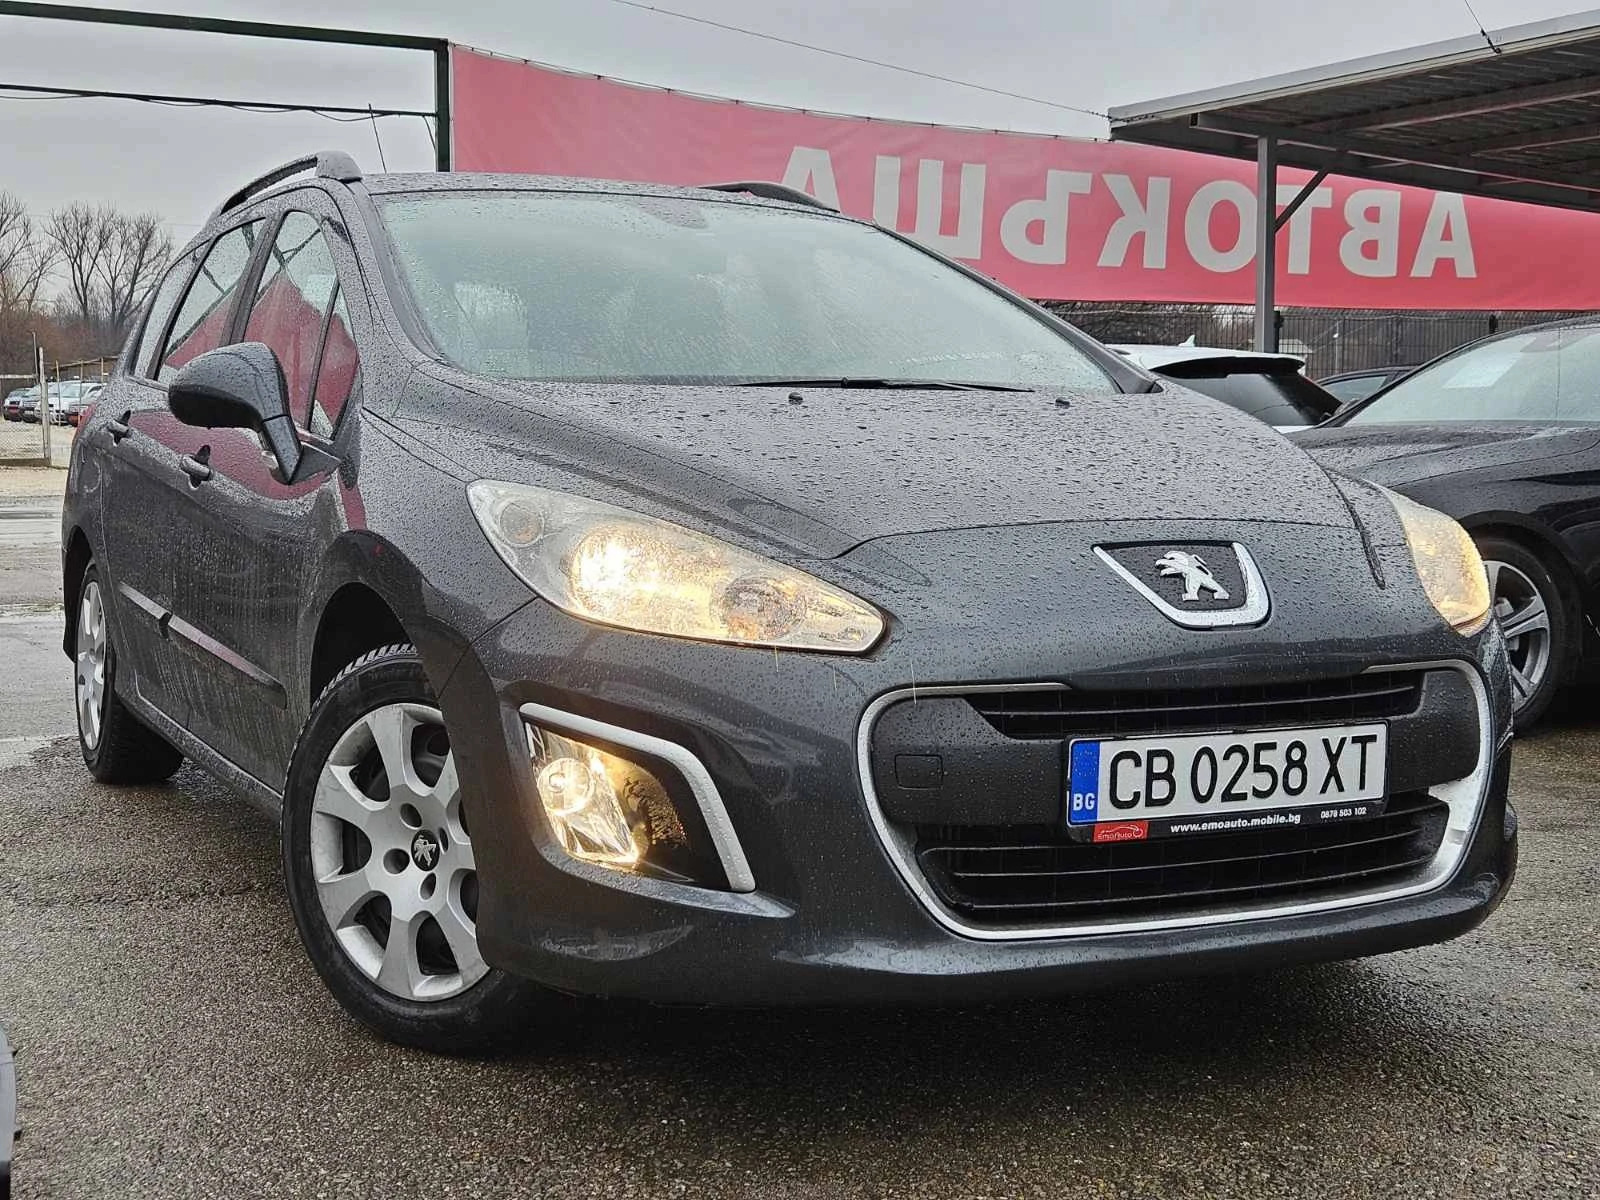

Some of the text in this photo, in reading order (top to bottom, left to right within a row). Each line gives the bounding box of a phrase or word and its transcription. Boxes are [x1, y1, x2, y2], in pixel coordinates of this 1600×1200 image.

[1109, 734, 1378, 810] CB 0258 XT
[1073, 792, 1096, 811] BG
[1354, 806, 1367, 816] 102
[1170, 813, 1301, 833] www.emoauto.mobile.bg
